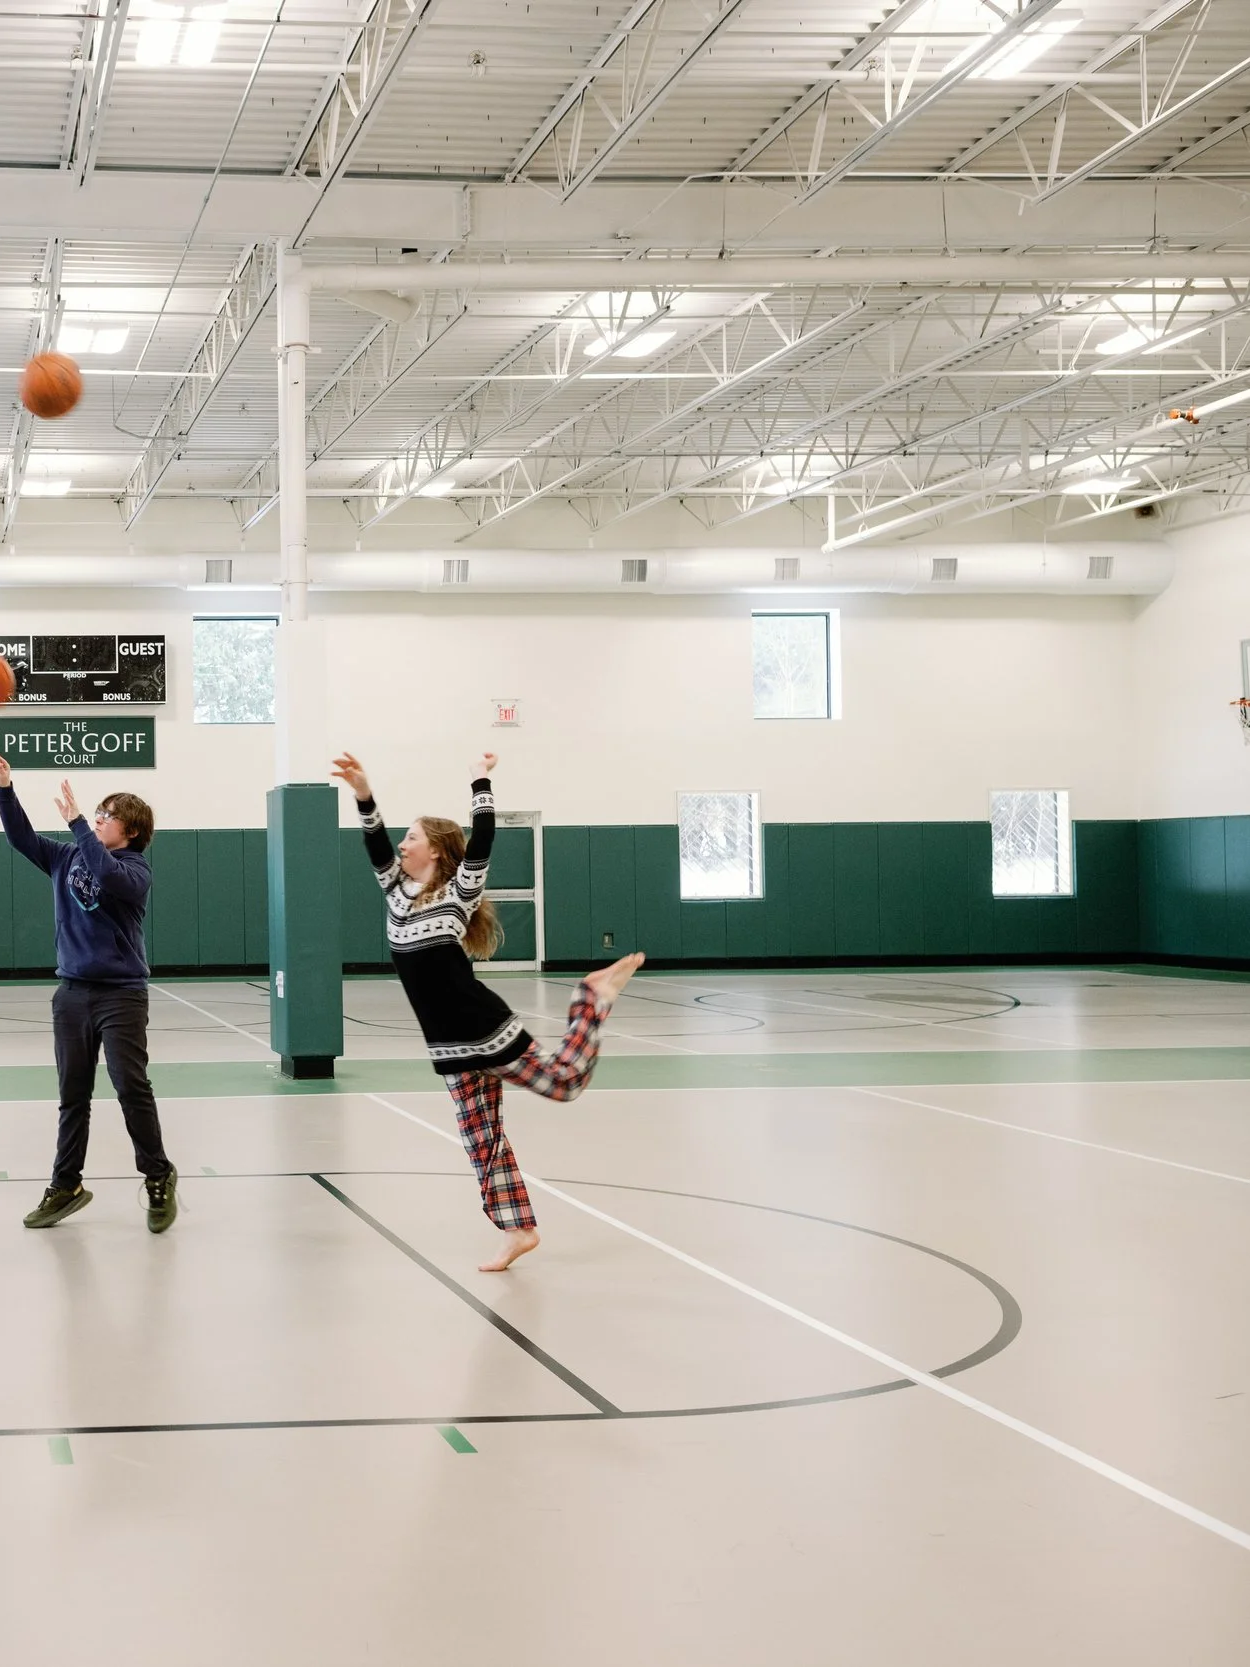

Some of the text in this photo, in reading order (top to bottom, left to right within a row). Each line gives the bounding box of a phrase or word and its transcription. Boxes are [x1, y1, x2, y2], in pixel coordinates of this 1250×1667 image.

[118, 642, 164, 656] GUEST
[18, 693, 47, 702] BONUS
[102, 693, 131, 701] BONUS
[63, 721, 88, 732] THE
[3, 732, 146, 753] PETER GOFF
[53, 754, 97, 765] COURT
